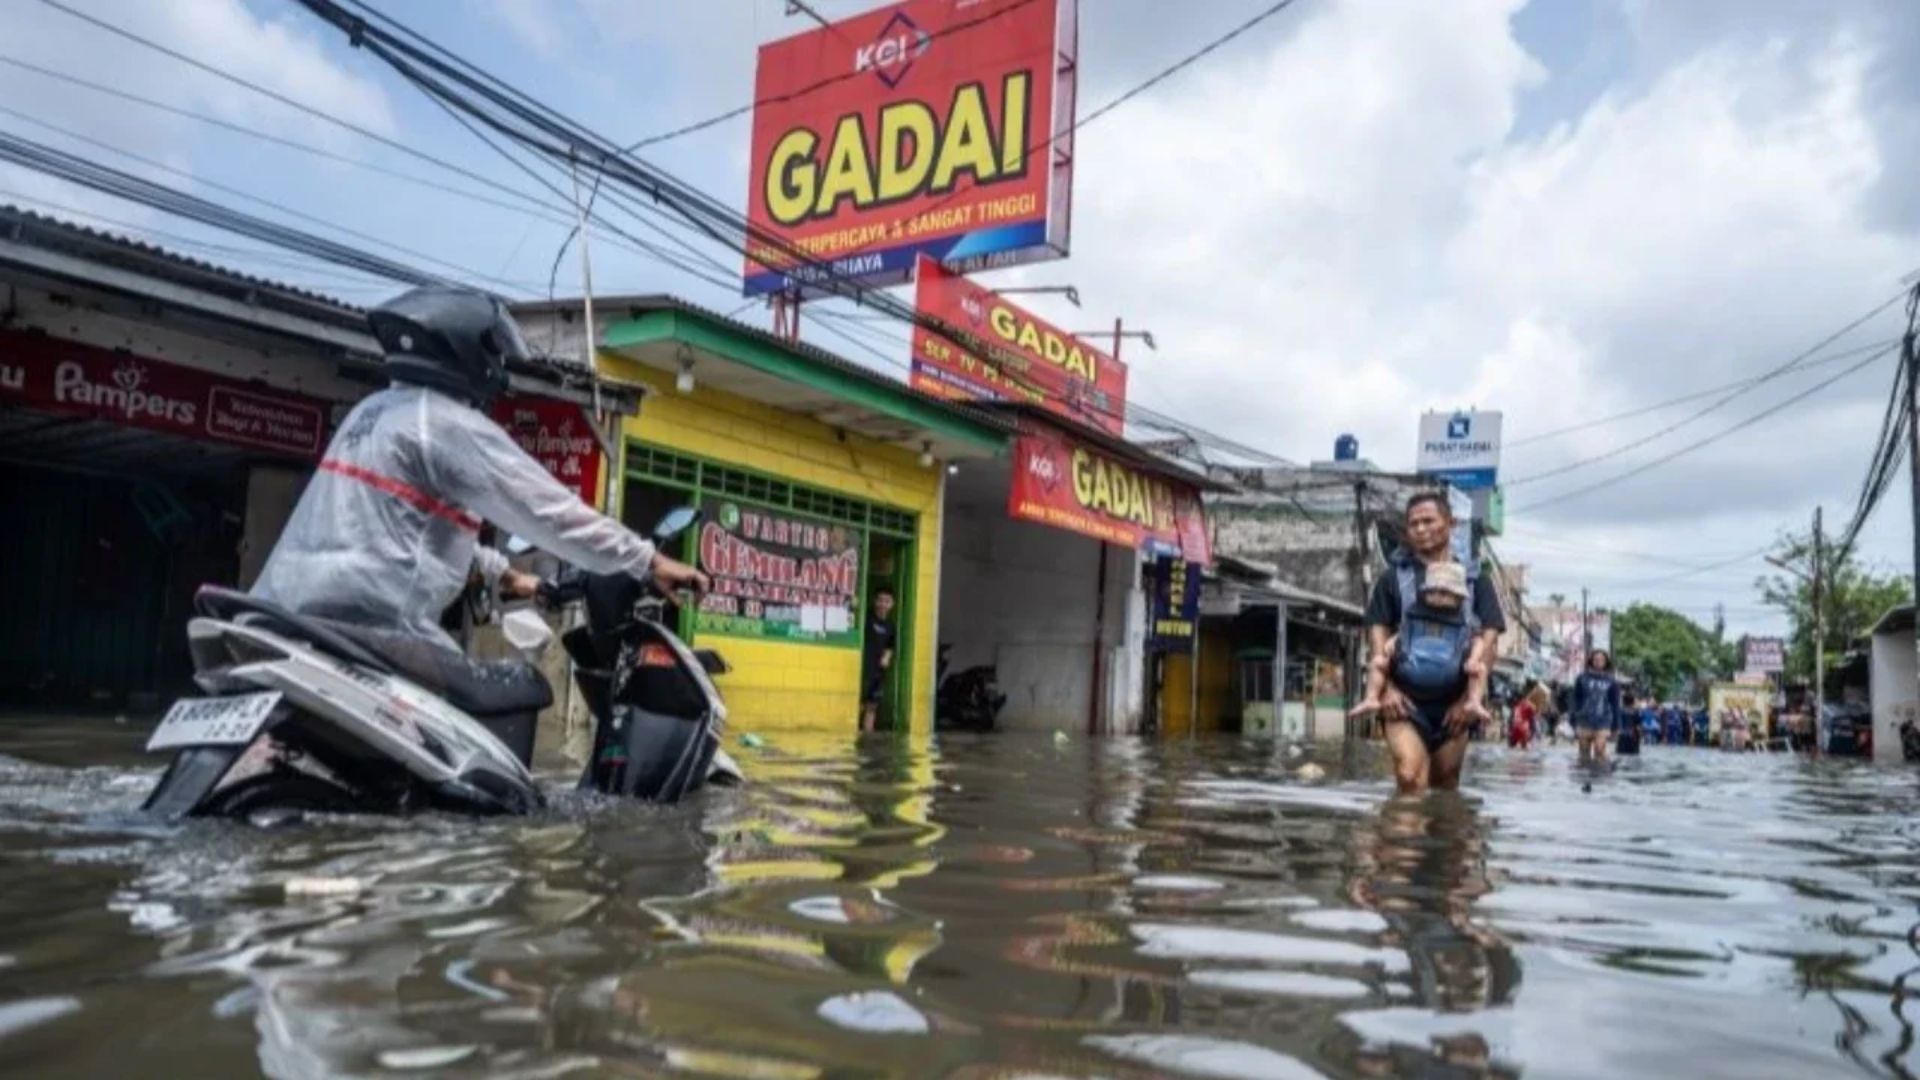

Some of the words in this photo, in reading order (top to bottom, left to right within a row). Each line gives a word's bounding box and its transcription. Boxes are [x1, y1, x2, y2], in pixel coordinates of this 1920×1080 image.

[765, 70, 1032, 227] GADAI
[909, 205, 973, 237] SANGAT
[979, 193, 1036, 229] TINGGI
[990, 305, 1097, 383] GADAI
[54, 360, 198, 425] Pampers
[1071, 447, 1154, 528] GADAI
[702, 521, 858, 595] GEMILANG
